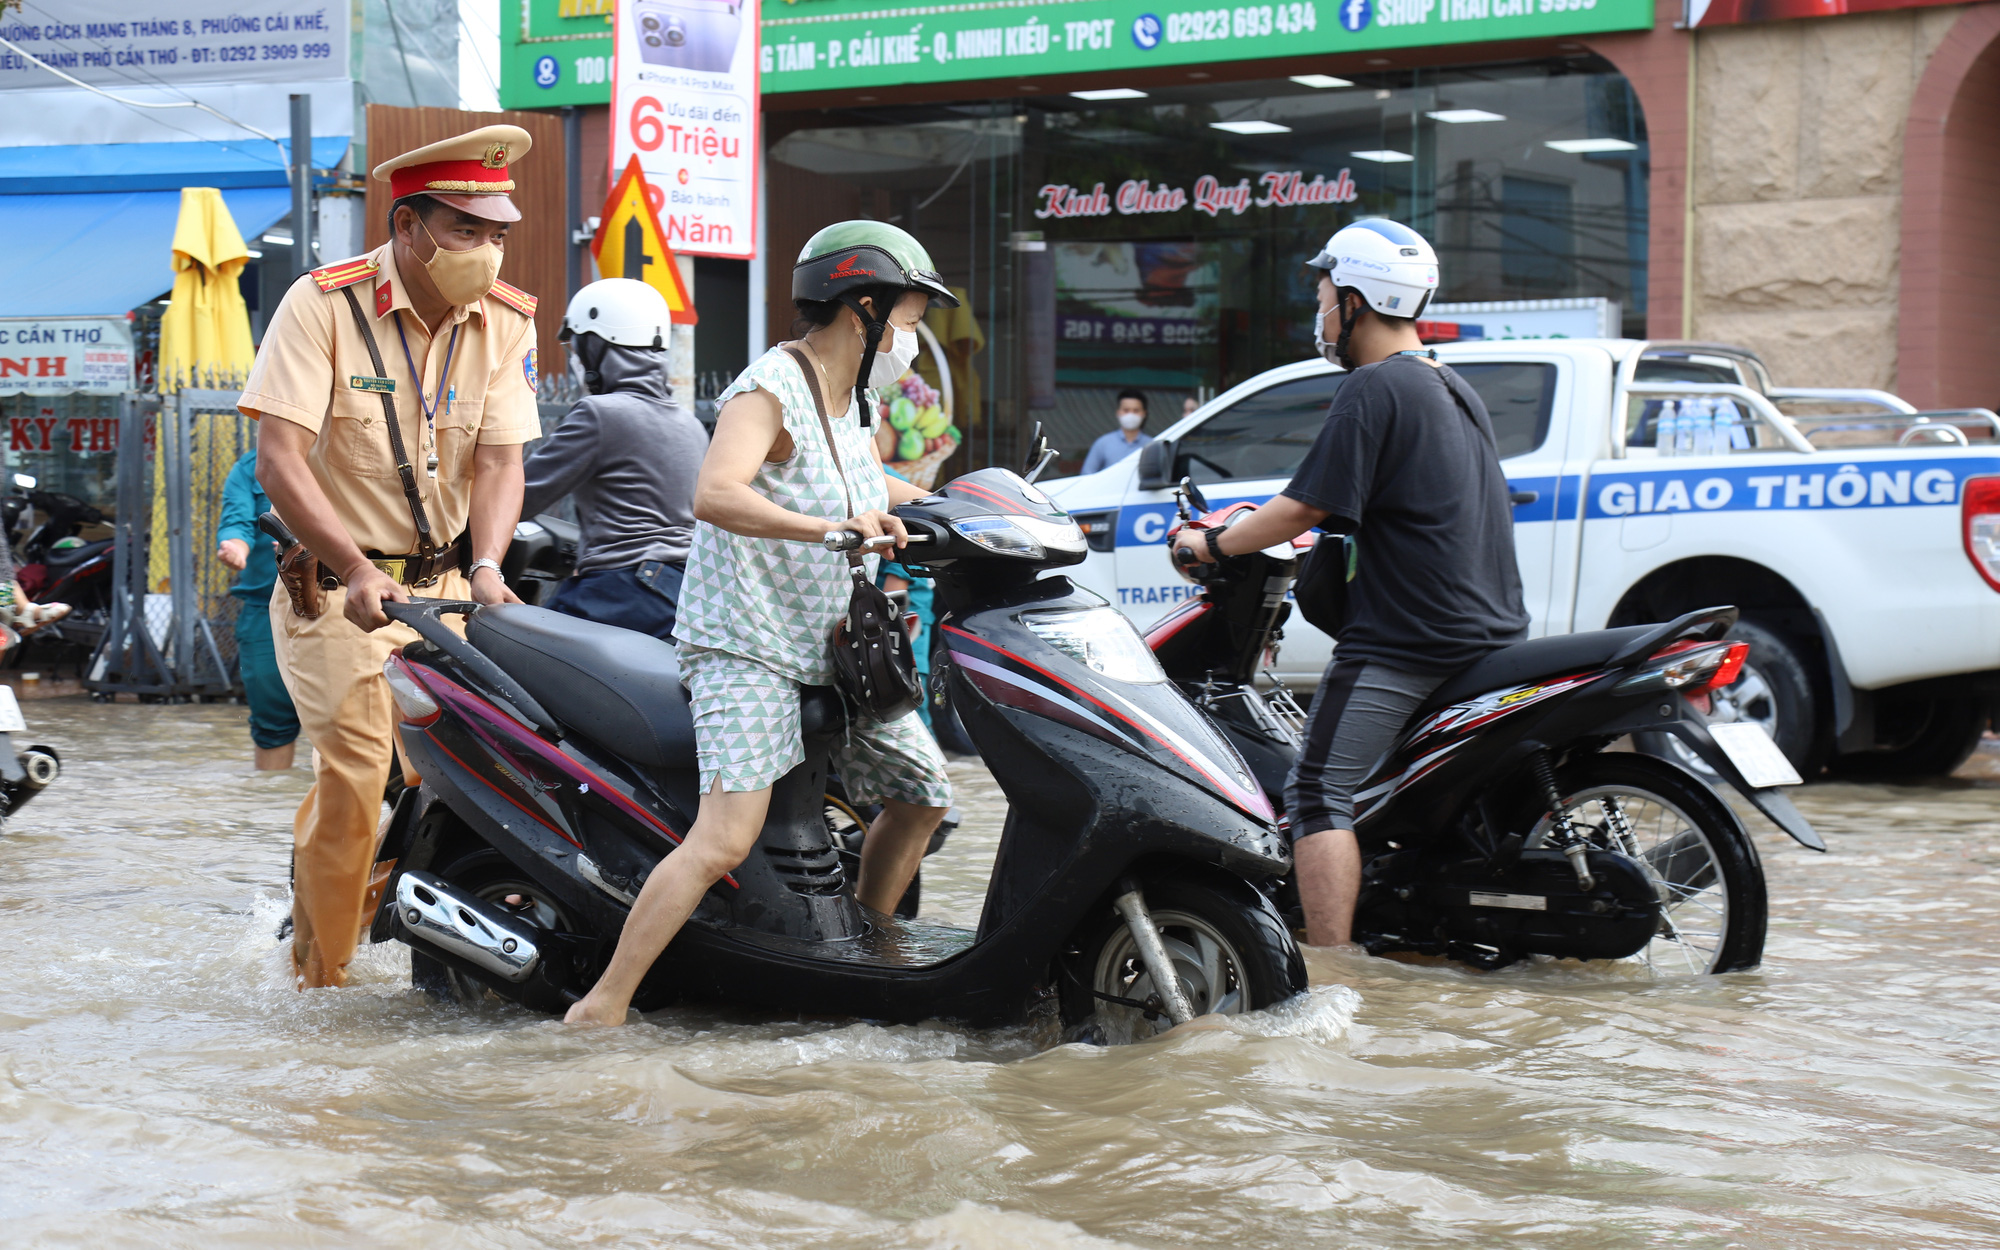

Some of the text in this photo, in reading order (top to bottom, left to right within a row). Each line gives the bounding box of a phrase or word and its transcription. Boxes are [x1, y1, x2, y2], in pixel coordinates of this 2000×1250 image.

[45, 21, 81, 40] CÁCH
[86, 23, 126, 42] MẠNG
[130, 17, 179, 37] THÁNG
[183, 20, 197, 37] 8,
[201, 13, 261, 34] PHƯỜNG
[265, 11, 289, 31] CÁI
[1166, 1, 1317, 43] 02923 693 434
[1377, 0, 1435, 27] SHOP
[83, 46, 112, 66] PHỐ
[149, 46, 178, 65] THƠ
[192, 48, 216, 63] ĐT:
[220, 46, 256, 62] 0292
[261, 44, 298, 60] 3909
[303, 43, 330, 58] 999
[575, 56, 606, 85] 100
[776, 35, 816, 72] TÁM
[849, 30, 880, 67] CÁI
[883, 23, 923, 64] KHẾ
[956, 28, 1003, 59] NINH
[1064, 19, 1115, 51] TPCT
[692, 78, 709, 89] Pro
[712, 80, 735, 91] Max
[629, 95, 664, 152] 6
[667, 102, 741, 122] Ưu đãi đến
[667, 124, 739, 165] Triệu
[697, 192, 730, 207] hành
[1034, 167, 1358, 219] Kính Chào Quý Khách
[666, 214, 733, 244] Năm
[62, 326, 102, 343] THƠ
[9, 408, 58, 451] KỸ
[1598, 464, 1956, 516] GIAO THÔNG
